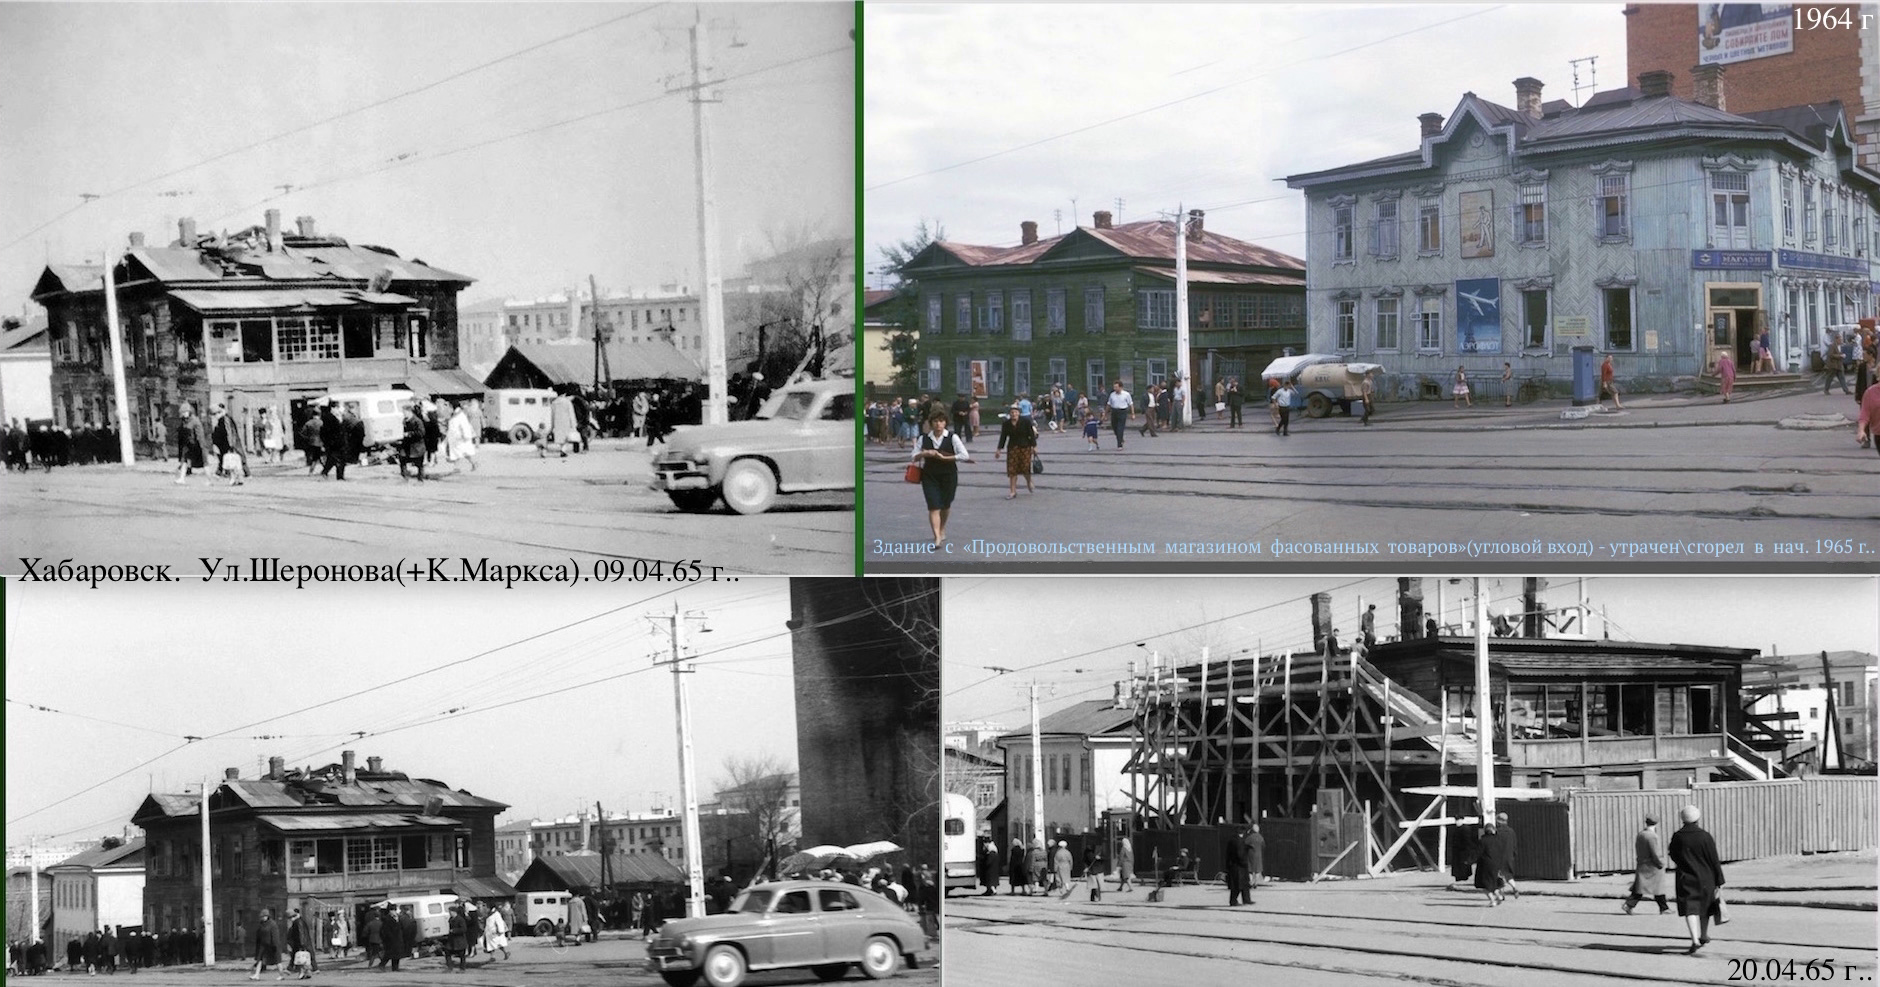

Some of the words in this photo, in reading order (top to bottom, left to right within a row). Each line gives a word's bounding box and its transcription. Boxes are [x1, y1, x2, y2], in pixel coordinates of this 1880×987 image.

[1725, 32, 1767, 49] СОБИРАЙТЕ
[1770, 29, 1789, 42] ЛОМ
[1722, 255, 1768, 263] МАГАЗИН
[1458, 341, 1499, 351] АЭРОФЛОТ
